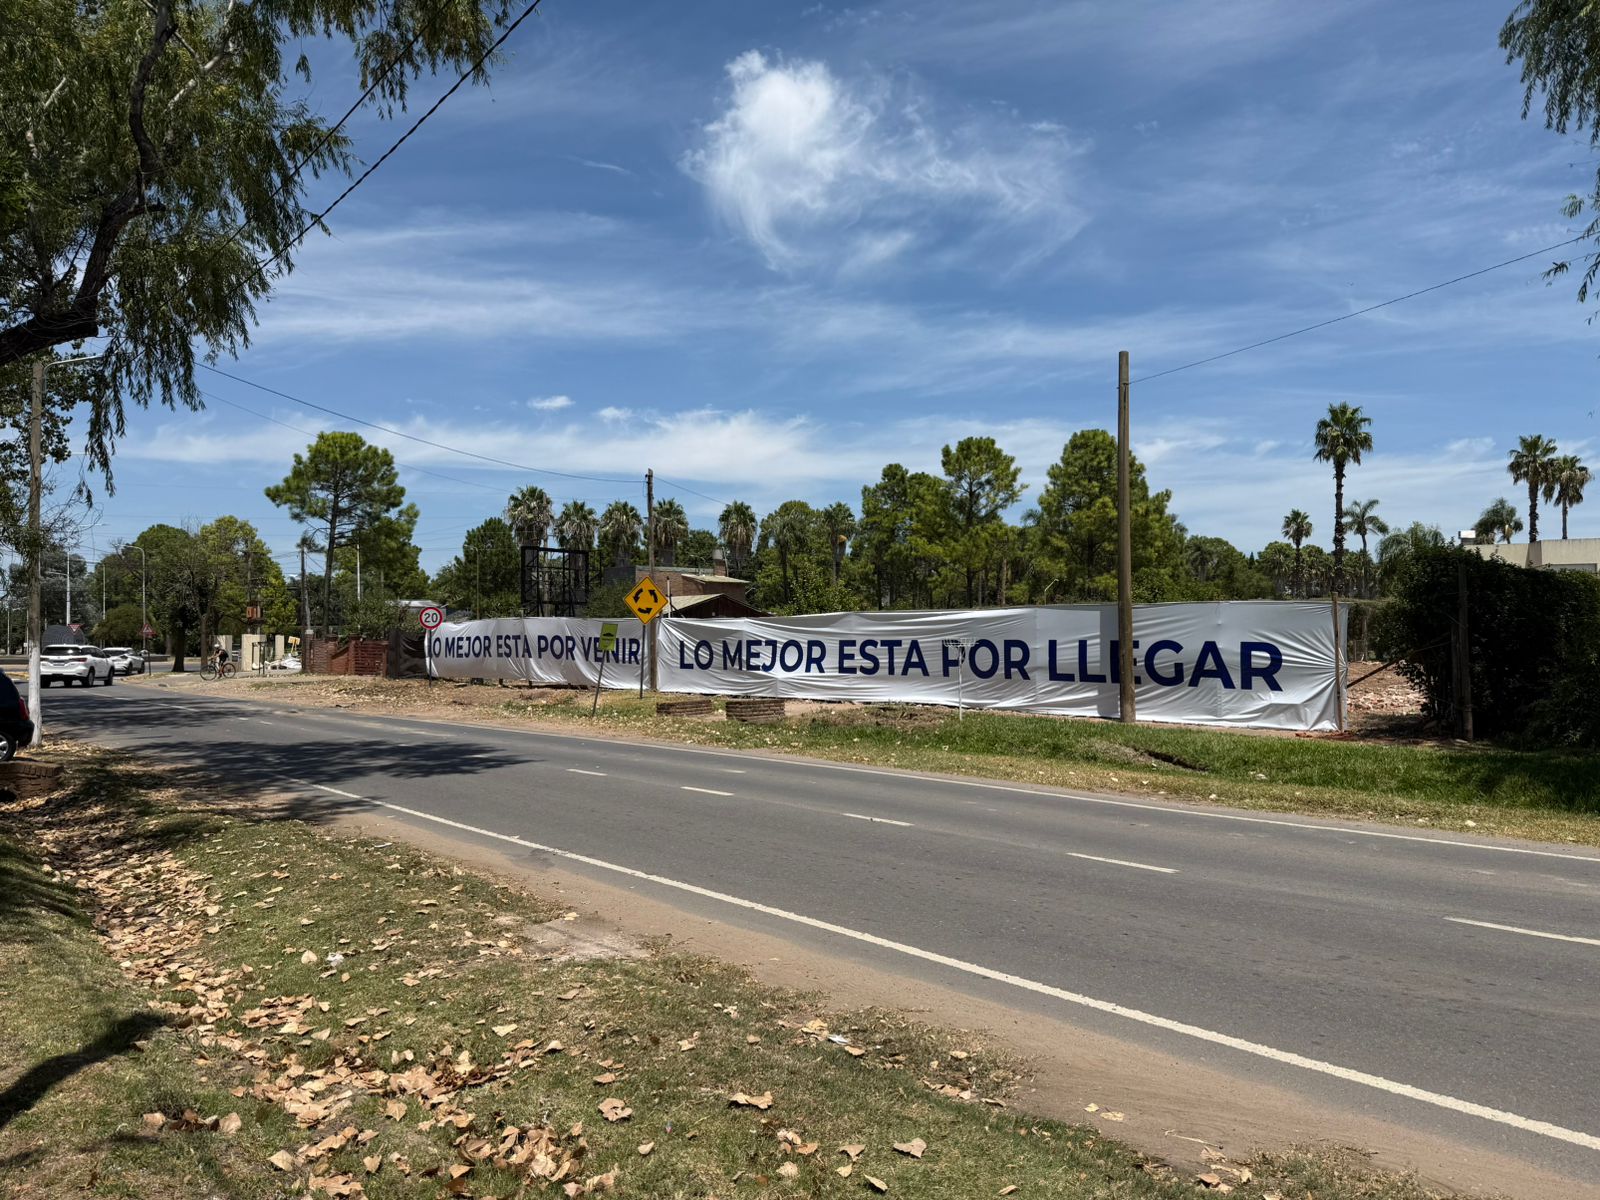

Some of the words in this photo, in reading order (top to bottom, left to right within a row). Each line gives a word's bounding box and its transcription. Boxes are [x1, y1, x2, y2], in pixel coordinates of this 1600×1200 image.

[424, 612, 438, 623] 20
[445, 635, 492, 658] MEJOR
[496, 634, 532, 659] ESTA
[537, 634, 576, 661] POR
[580, 636, 641, 665] VENIR
[679, 640, 714, 670] LO
[722, 640, 826, 673] MEJOR
[838, 640, 930, 677] ESTA
[941, 638, 1031, 681] POR
[1048, 639, 1283, 692] LLEGAR
